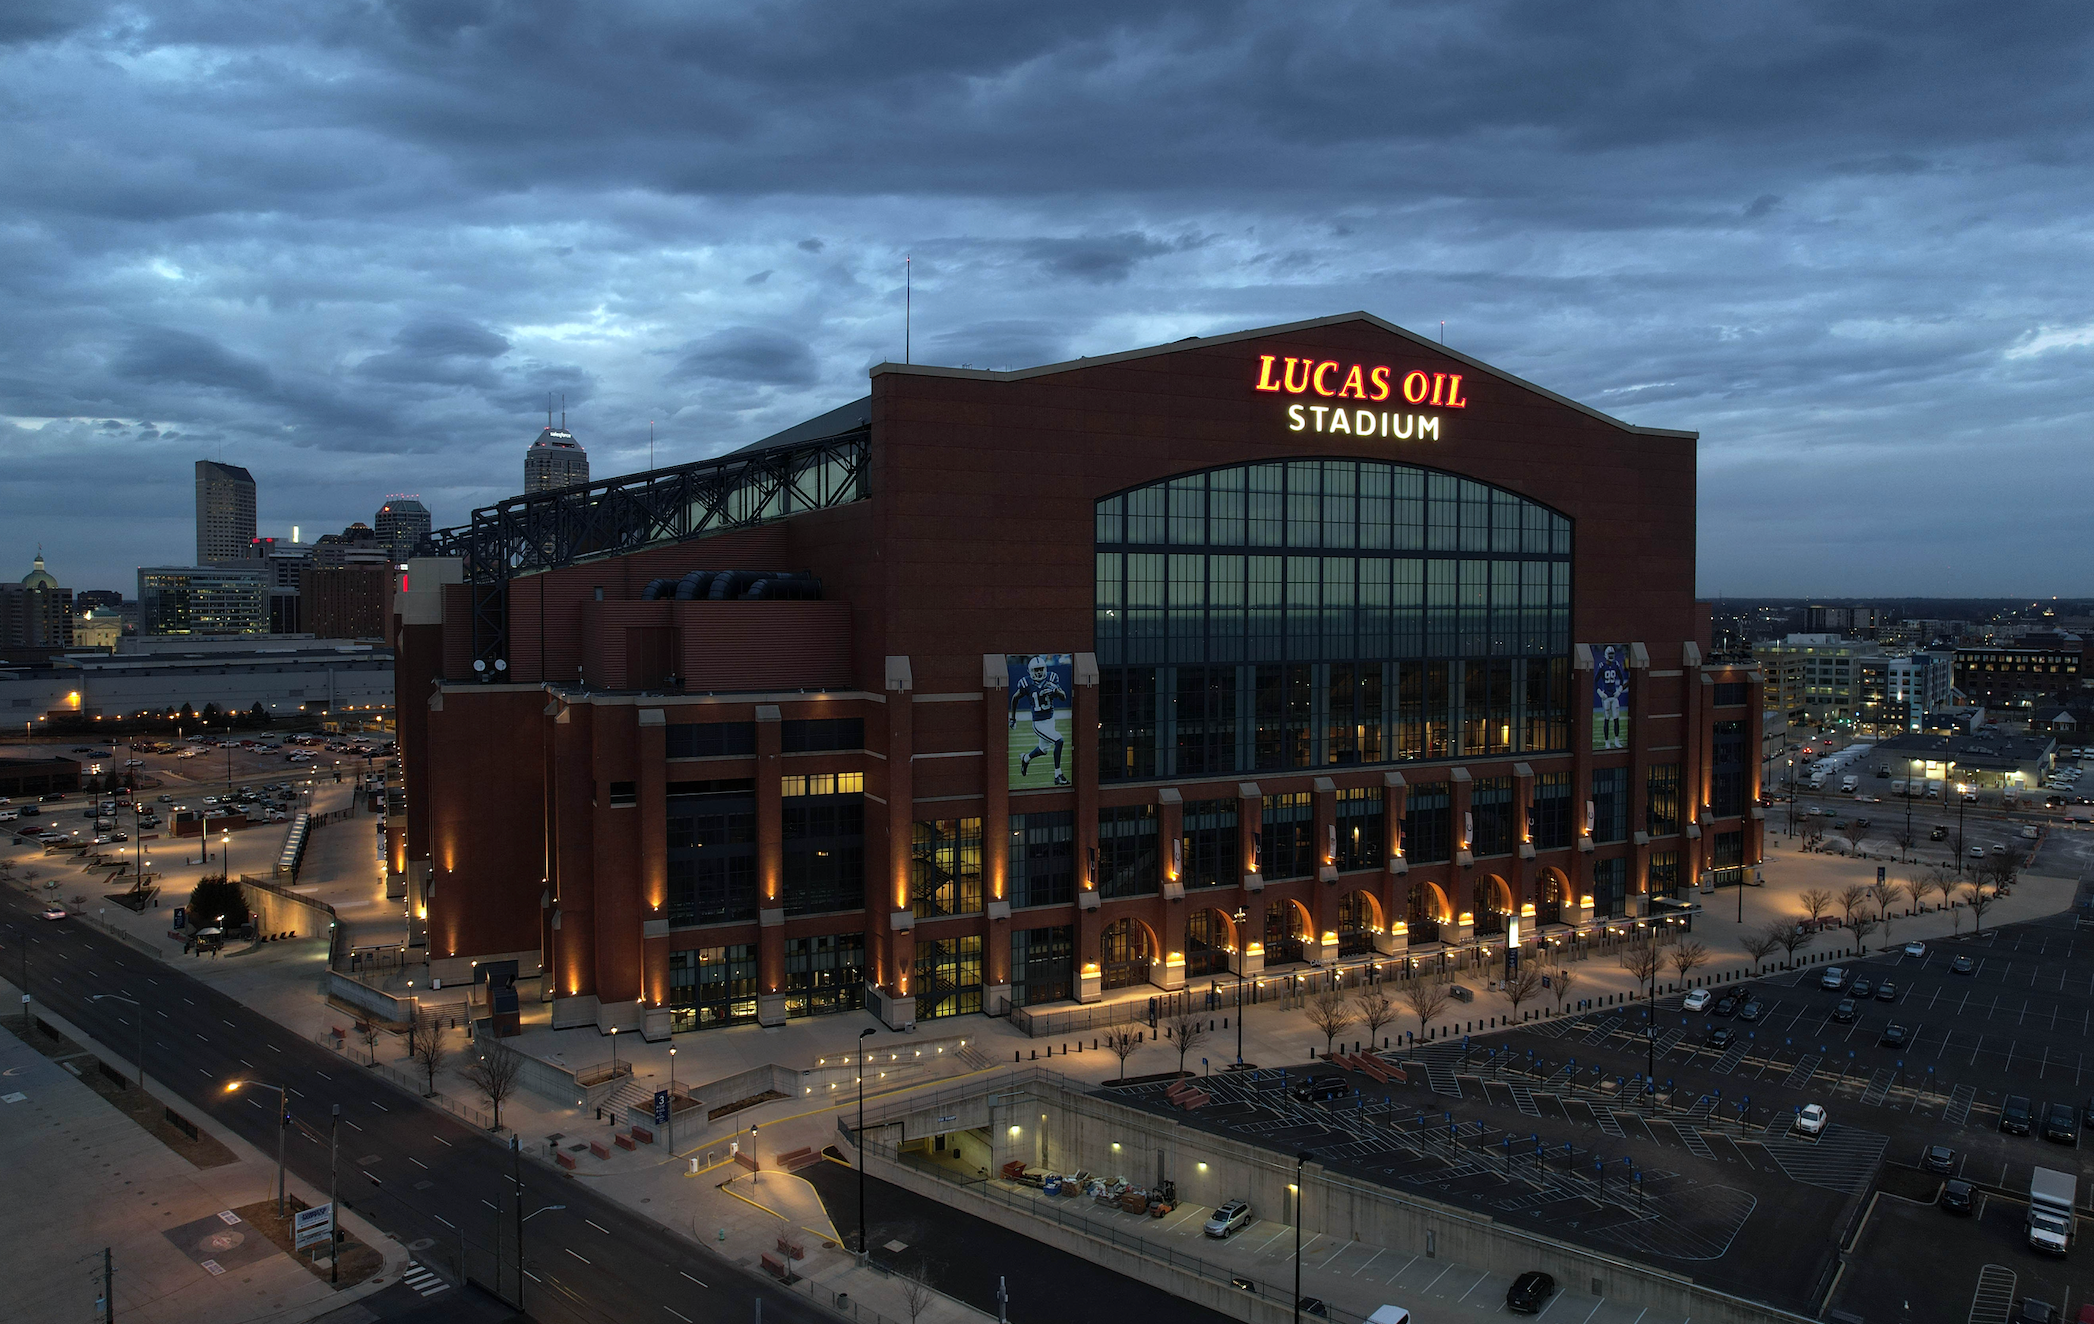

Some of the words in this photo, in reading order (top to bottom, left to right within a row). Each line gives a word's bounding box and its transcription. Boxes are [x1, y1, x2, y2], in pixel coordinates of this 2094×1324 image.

[1255, 354, 1391, 402] LUCAS
[1402, 369, 1468, 409] OIL
[1287, 403, 1440, 441] STADIUM
[1604, 669, 1617, 684] 99
[1031, 691, 1053, 712] 13
[658, 1095, 665, 1105] 3
